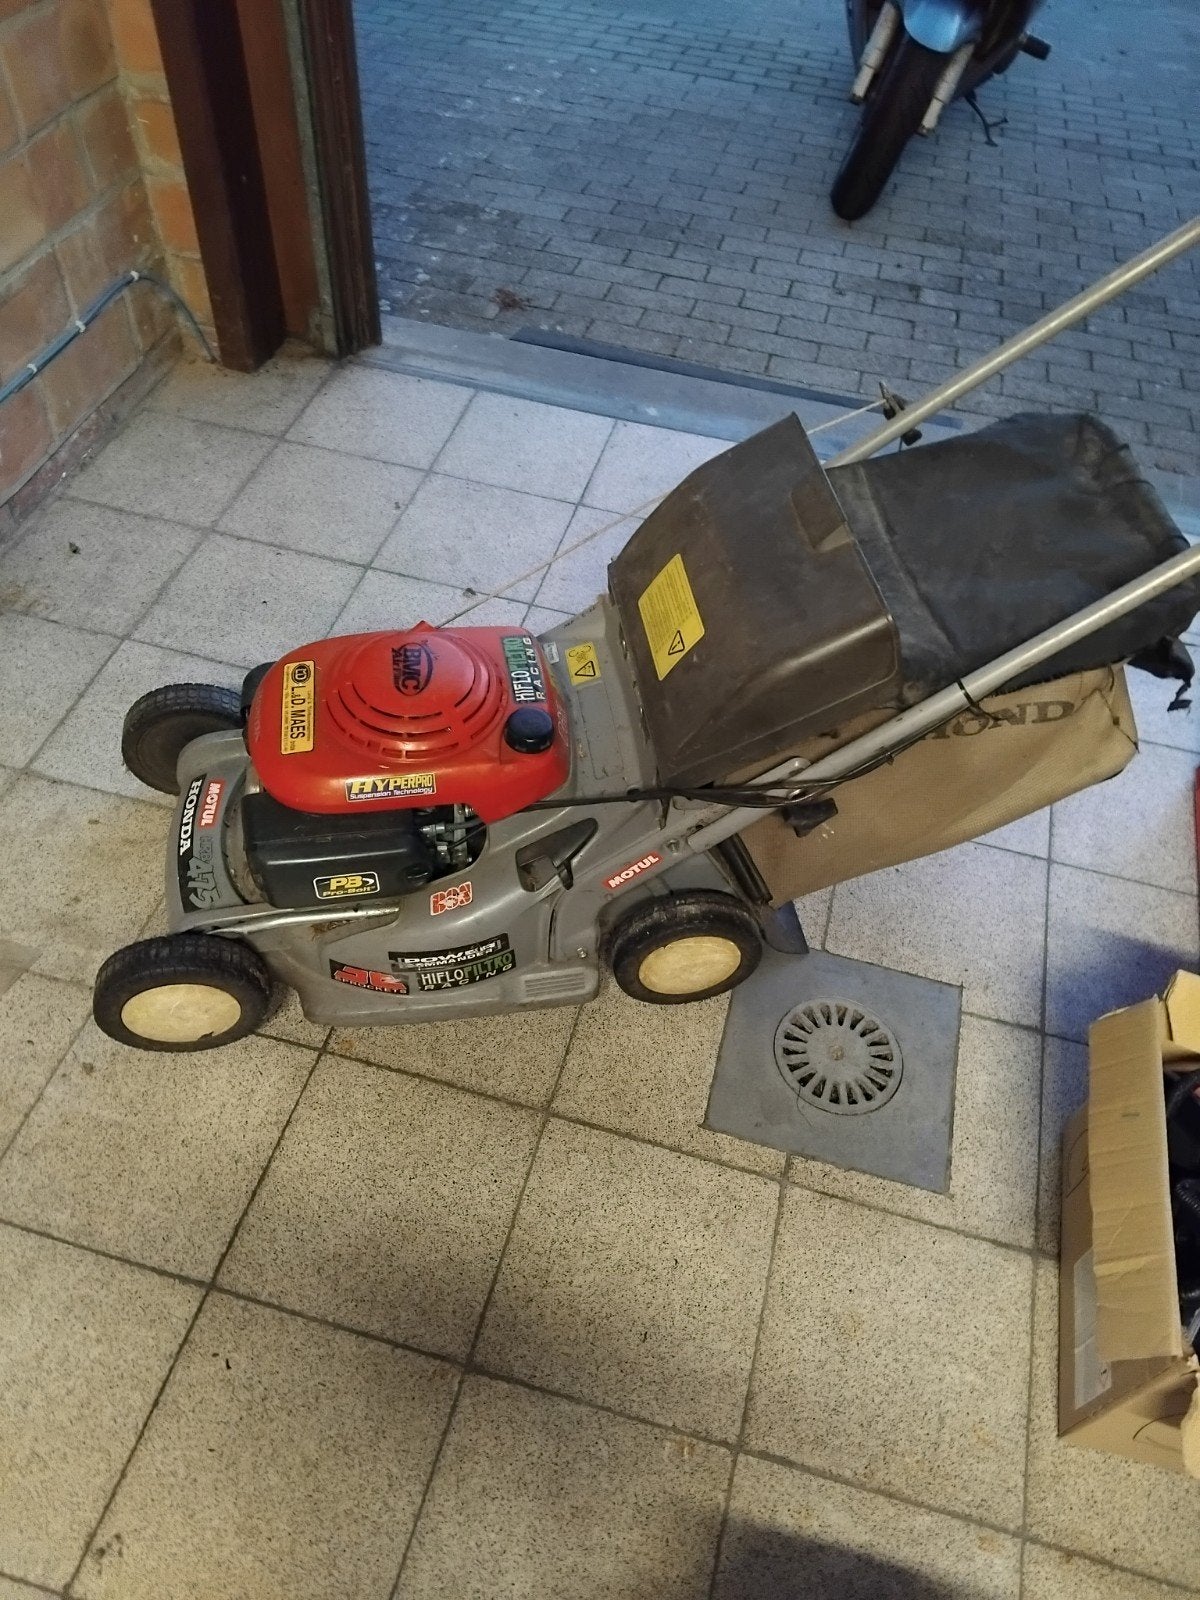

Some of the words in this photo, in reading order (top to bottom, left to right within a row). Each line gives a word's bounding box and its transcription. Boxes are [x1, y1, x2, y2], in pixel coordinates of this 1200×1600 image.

[401, 647, 421, 690] BMC
[523, 636, 546, 700] RACING
[289, 709, 306, 740] MAES
[350, 774, 433, 794] HYPERPRO
[350, 790, 392, 800] Suspension
[393, 787, 433, 796] Technology
[179, 779, 203, 856] HONDA
[201, 782, 221, 827] MOTUL
[330, 875, 363, 891] PB
[607, 854, 660, 888] MOTUL
[420, 950, 513, 986] HIFLOFILTRO
[423, 962, 513, 991] RACING
